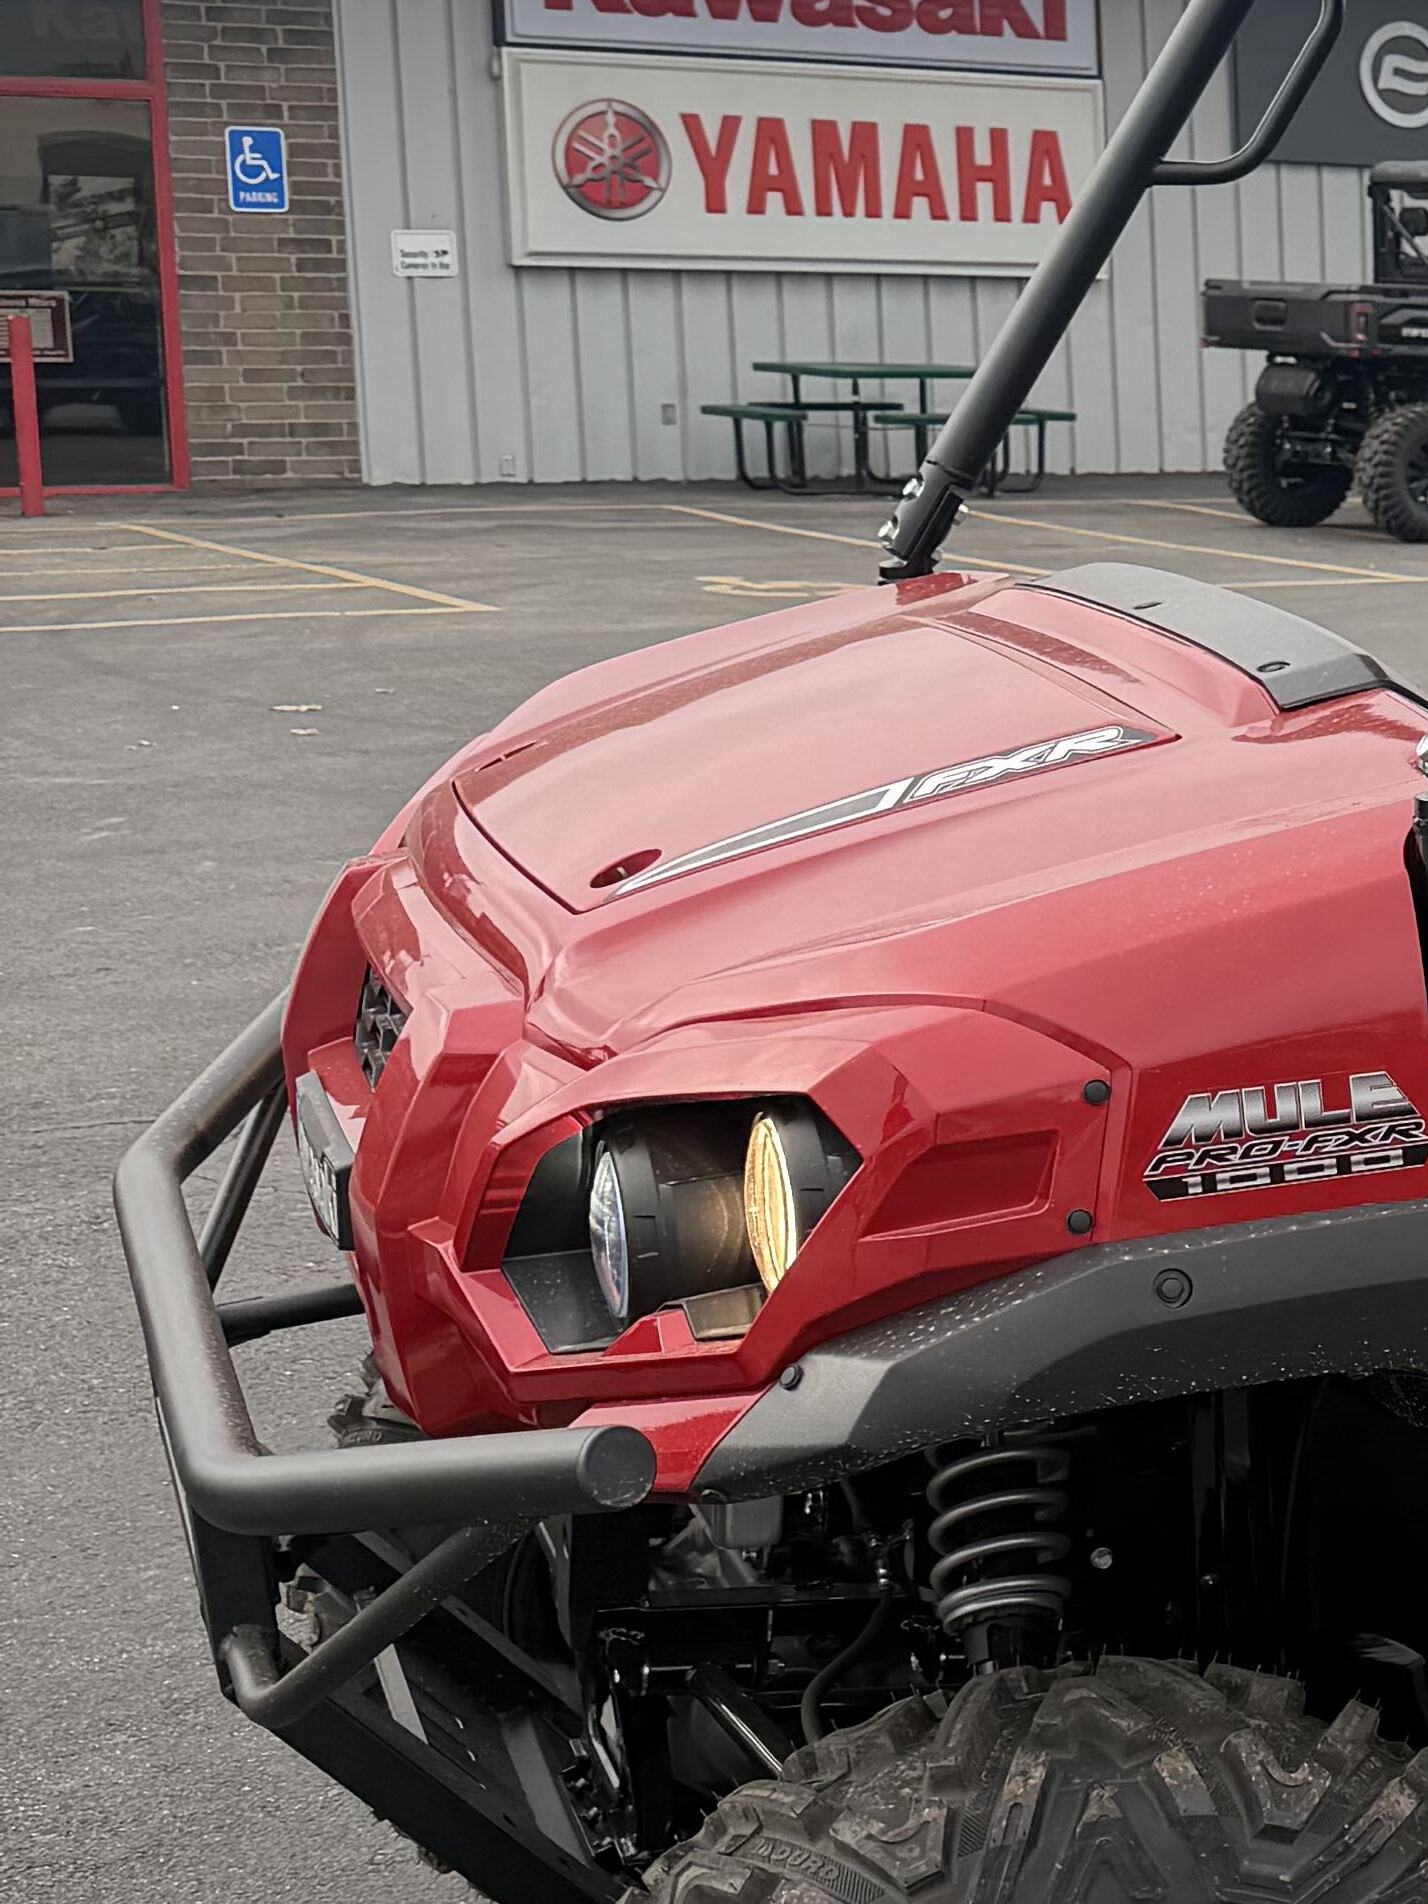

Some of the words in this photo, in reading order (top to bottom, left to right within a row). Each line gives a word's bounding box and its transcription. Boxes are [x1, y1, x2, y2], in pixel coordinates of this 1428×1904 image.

[679, 112, 1074, 225] YAMAHA
[902, 725, 1146, 804] FXR
[1158, 1071, 1422, 1150] MULE
[1182, 1149, 1404, 1195] 1000
